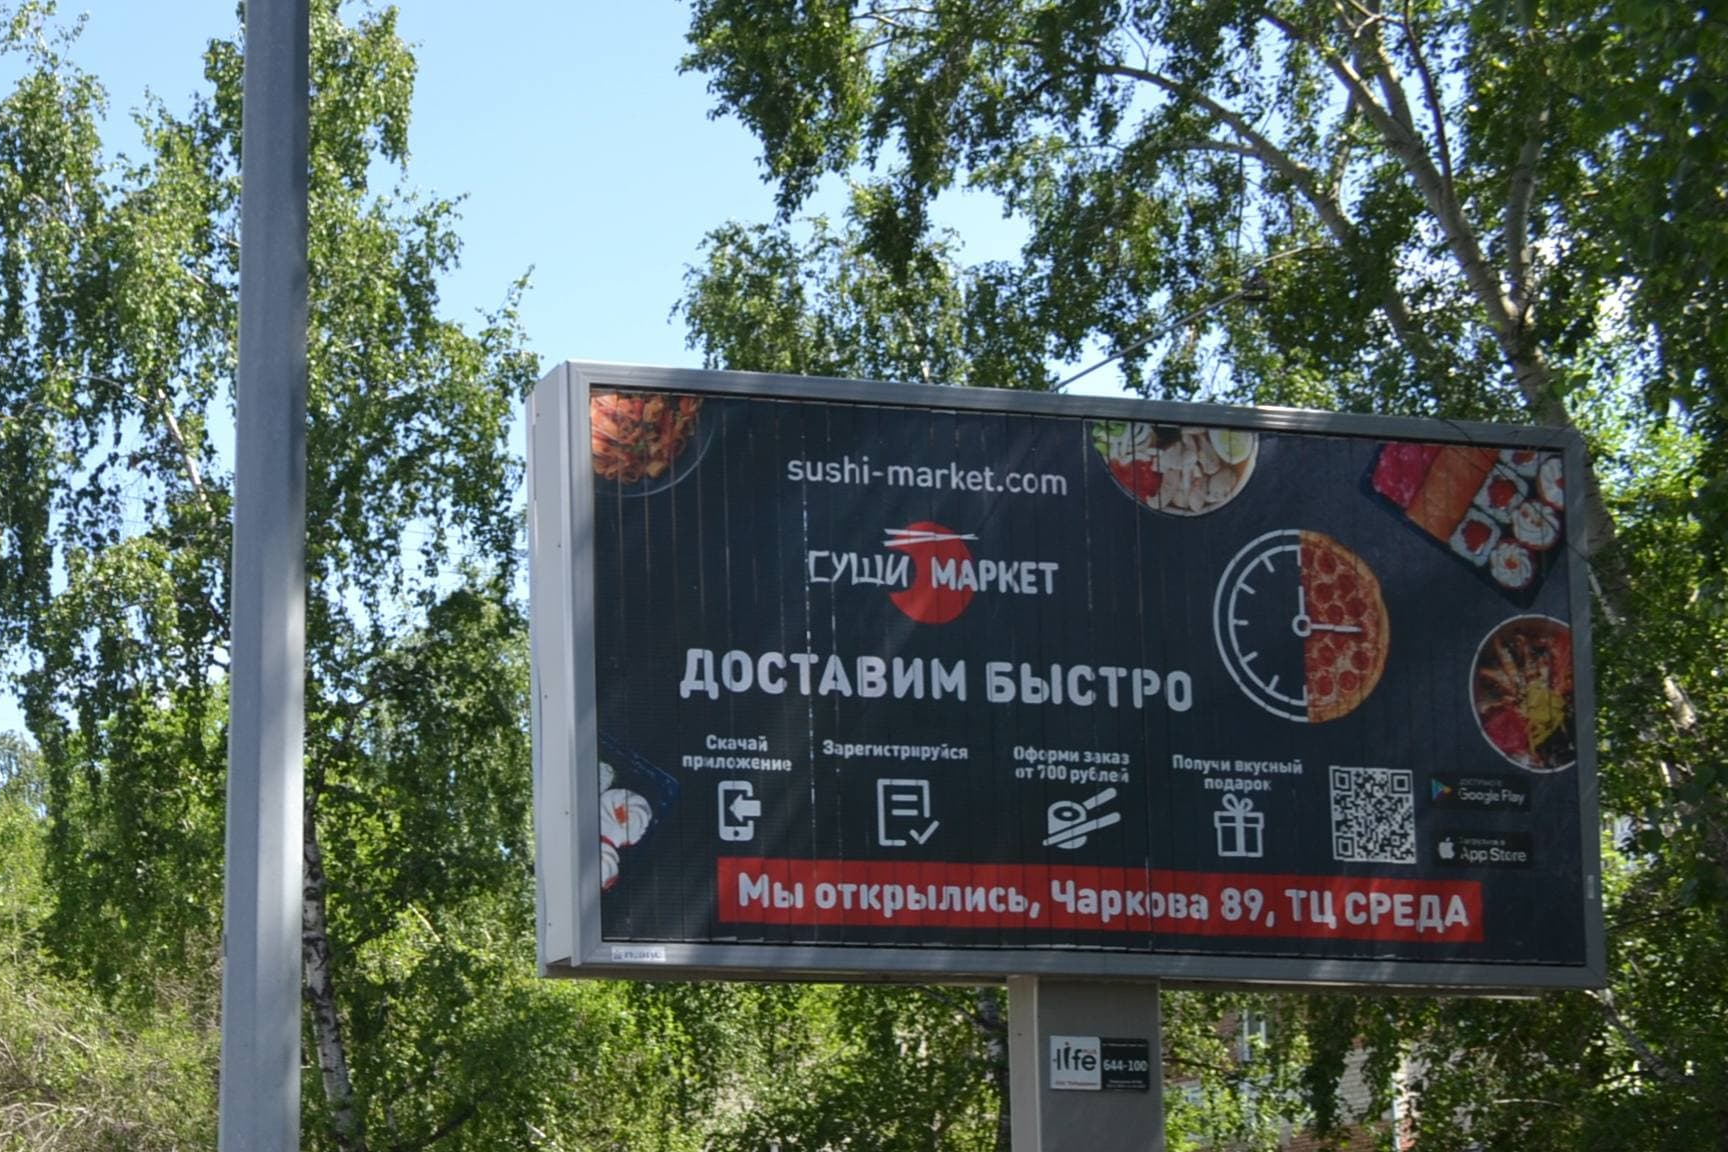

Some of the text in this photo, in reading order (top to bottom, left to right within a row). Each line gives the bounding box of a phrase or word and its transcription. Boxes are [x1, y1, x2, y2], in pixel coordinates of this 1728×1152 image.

[788, 456, 1066, 495] sushi-market.com
[809, 551, 1058, 594] СУШИ МАРКЕТ
[680, 646, 1192, 711] ДОСТАВИМ БЫСТРО
[707, 735, 768, 752] Скачай
[823, 740, 968, 760] Зарегистрируйся
[683, 756, 792, 771] приложение
[1014, 746, 1129, 764] Оформи заказ
[1016, 765, 1128, 784] от 700 рублей
[1173, 755, 1302, 776] Получи вкусный
[1205, 778, 1270, 793] подарок
[1458, 787, 1525, 806] Google Play
[1460, 847, 1527, 863] App Store
[739, 872, 1469, 933] Мы открылись, Чаркова 89, ТЦ СРЕДА
